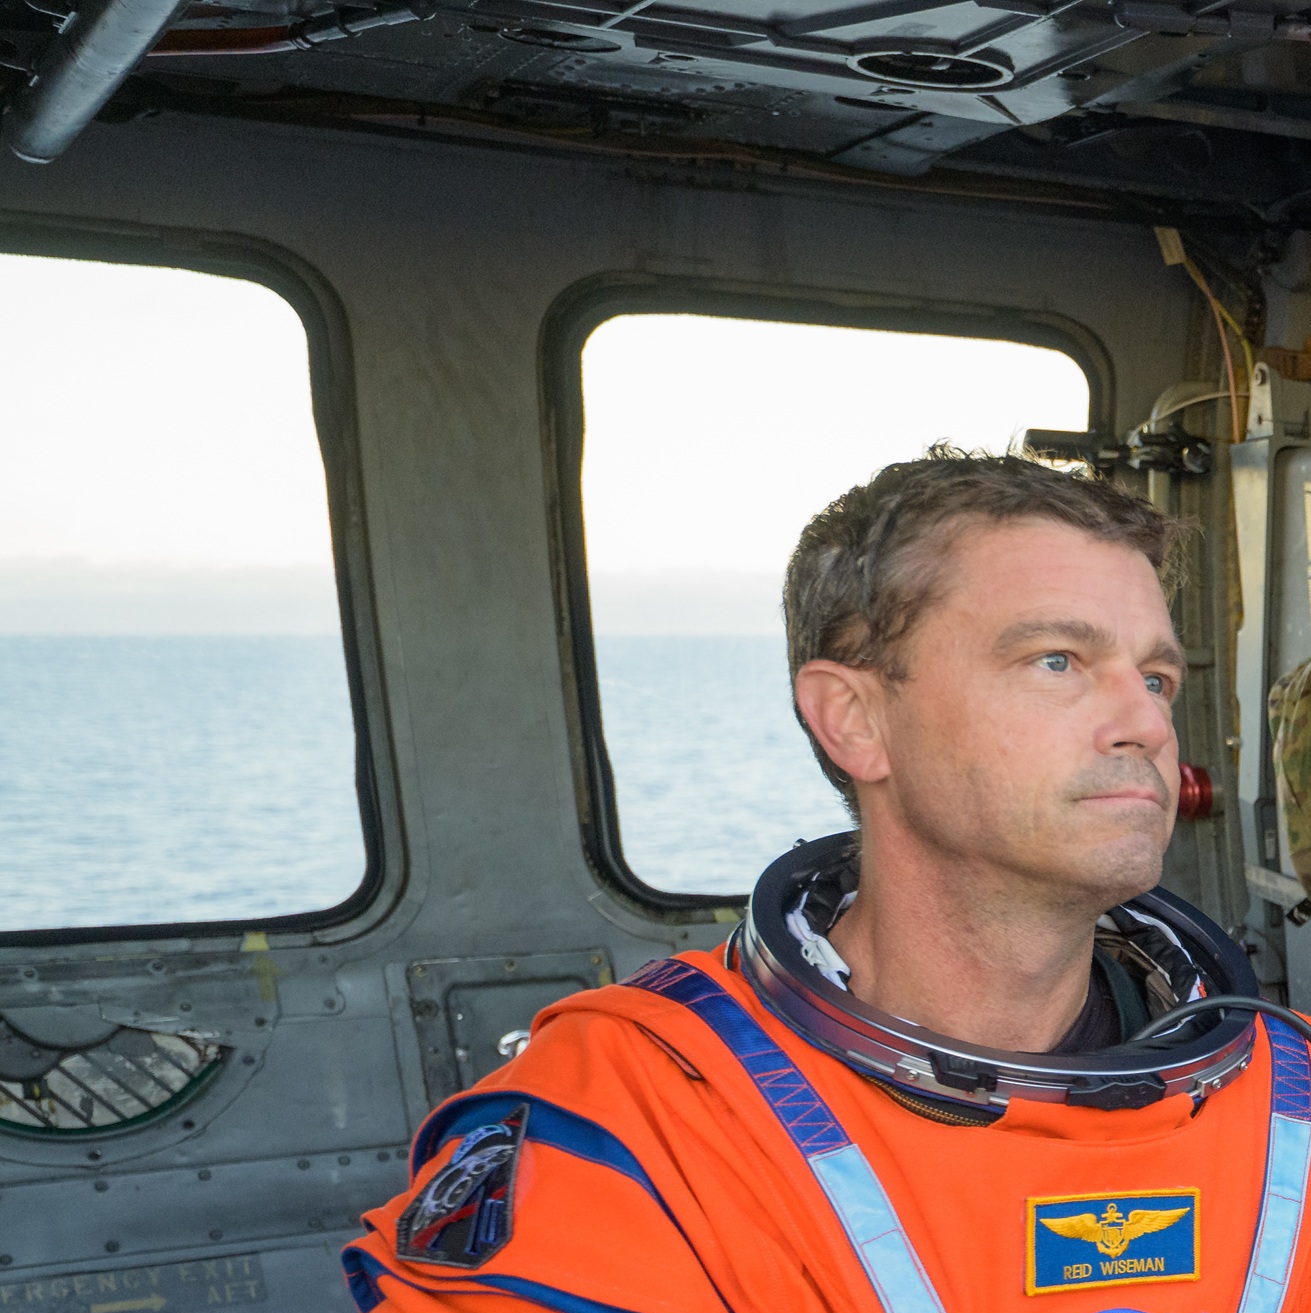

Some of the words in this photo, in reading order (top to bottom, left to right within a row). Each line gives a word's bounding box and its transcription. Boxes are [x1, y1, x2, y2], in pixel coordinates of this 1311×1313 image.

[1063, 1263, 1092, 1280] REID
[1099, 1257, 1165, 1276] WISEMAN
[207, 1279, 260, 1305] AFT
